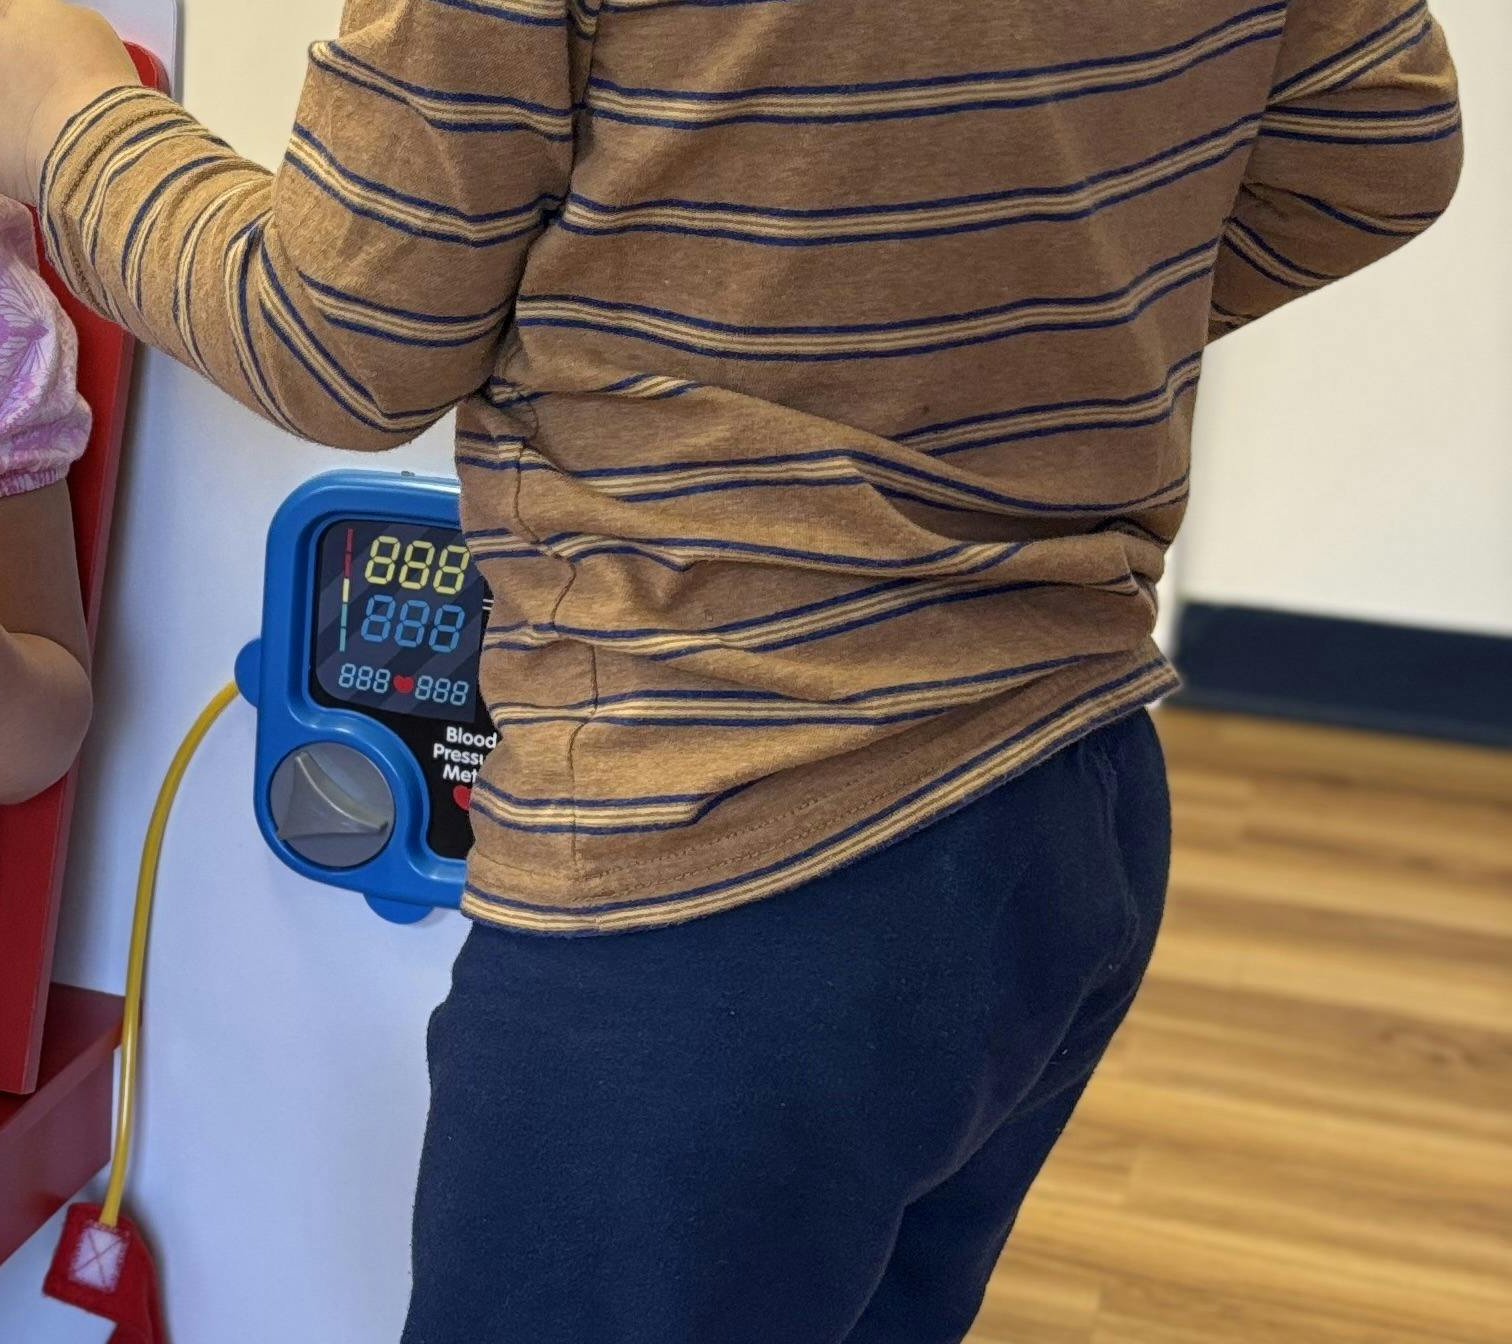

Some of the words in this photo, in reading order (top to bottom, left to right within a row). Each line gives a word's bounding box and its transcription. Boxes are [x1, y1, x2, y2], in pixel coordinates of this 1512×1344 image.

[365, 535, 470, 595] 888
[361, 594, 465, 653] 888
[338, 663, 391, 693] 888
[414, 676, 469, 706] 888
[446, 726, 498, 749] Blood
